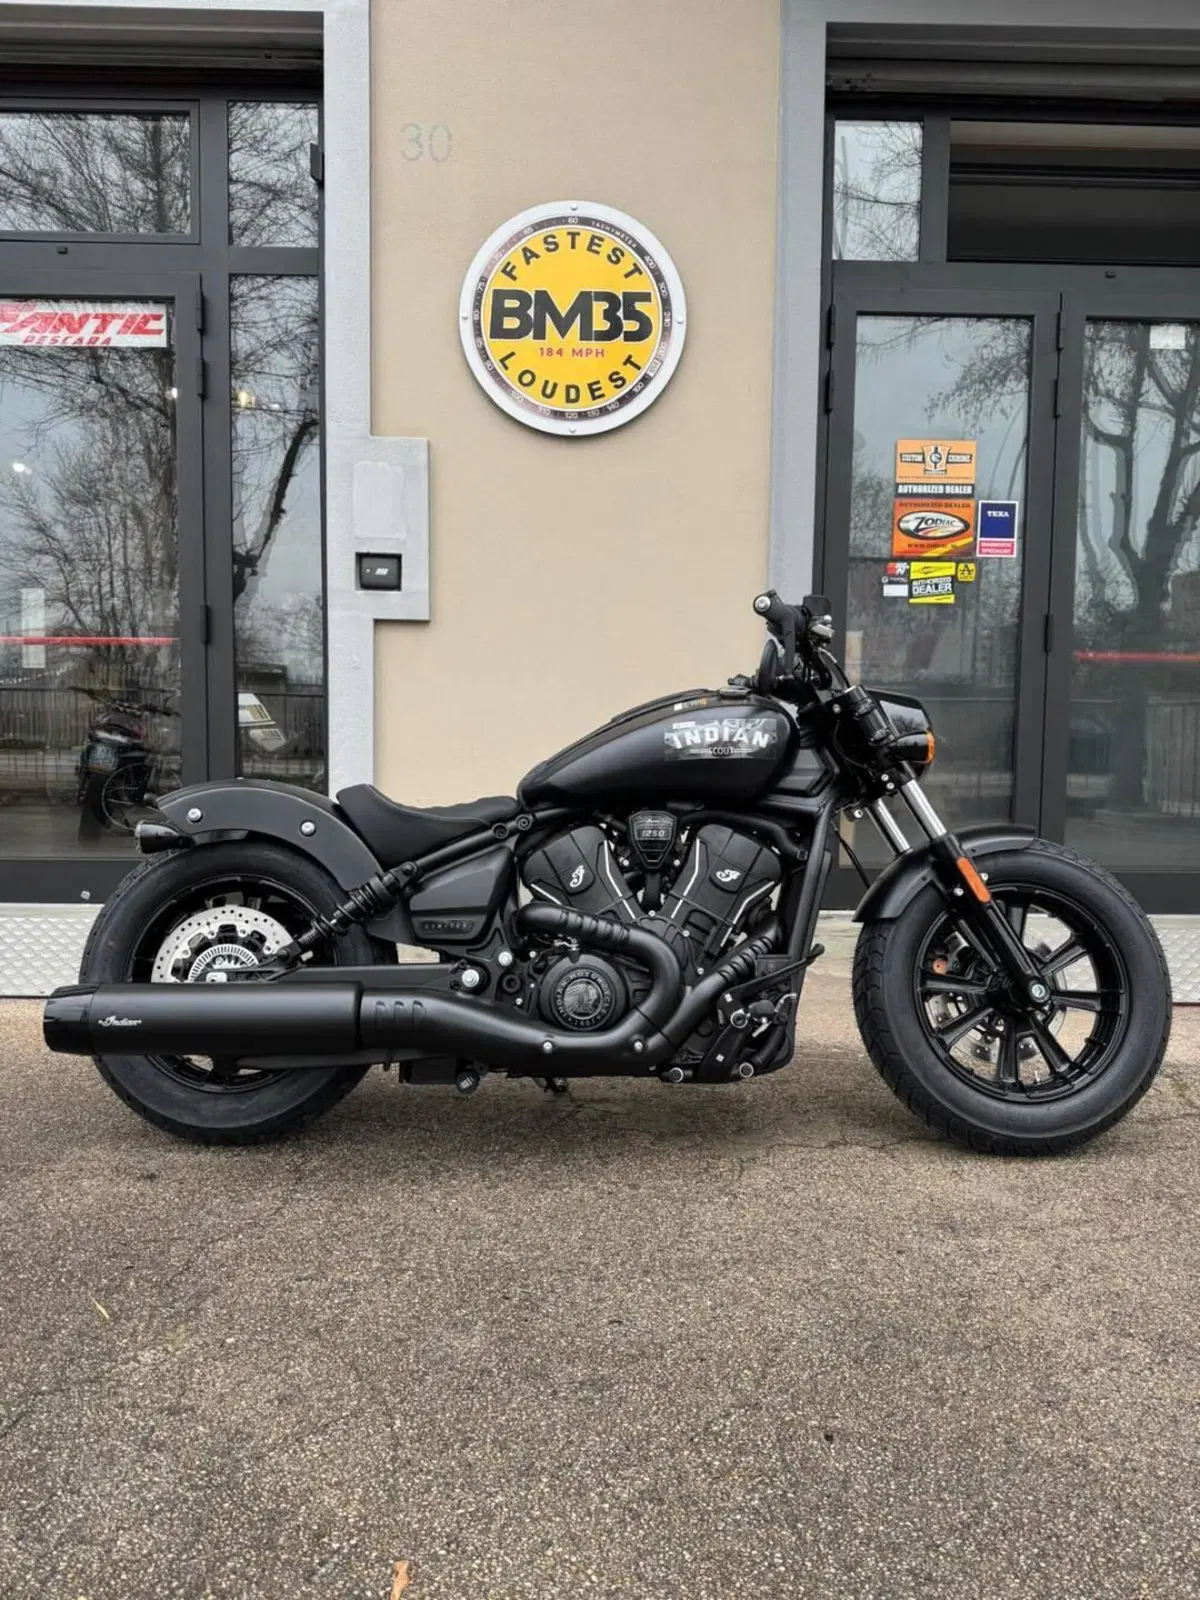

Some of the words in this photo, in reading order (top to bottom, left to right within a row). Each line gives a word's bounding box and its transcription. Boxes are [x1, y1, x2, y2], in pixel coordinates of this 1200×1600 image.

[400, 122, 453, 162] 30
[591, 221, 638, 249] TACHYMETER
[501, 231, 643, 281] FASTEST
[489, 289, 653, 343] BM35
[539, 347, 564, 357] 184
[572, 348, 605, 358] MPH
[499, 351, 642, 404] LOUDEST
[897, 485, 944, 494] AUTHORIZED
[945, 485, 973, 494] DEALER
[914, 516, 956, 532] ZODIAC
[912, 583, 953, 594] DEALER
[672, 726, 769, 749] INDIAN
[708, 746, 734, 755] SCOUT
[99, 1015, 141, 1027] Indian
